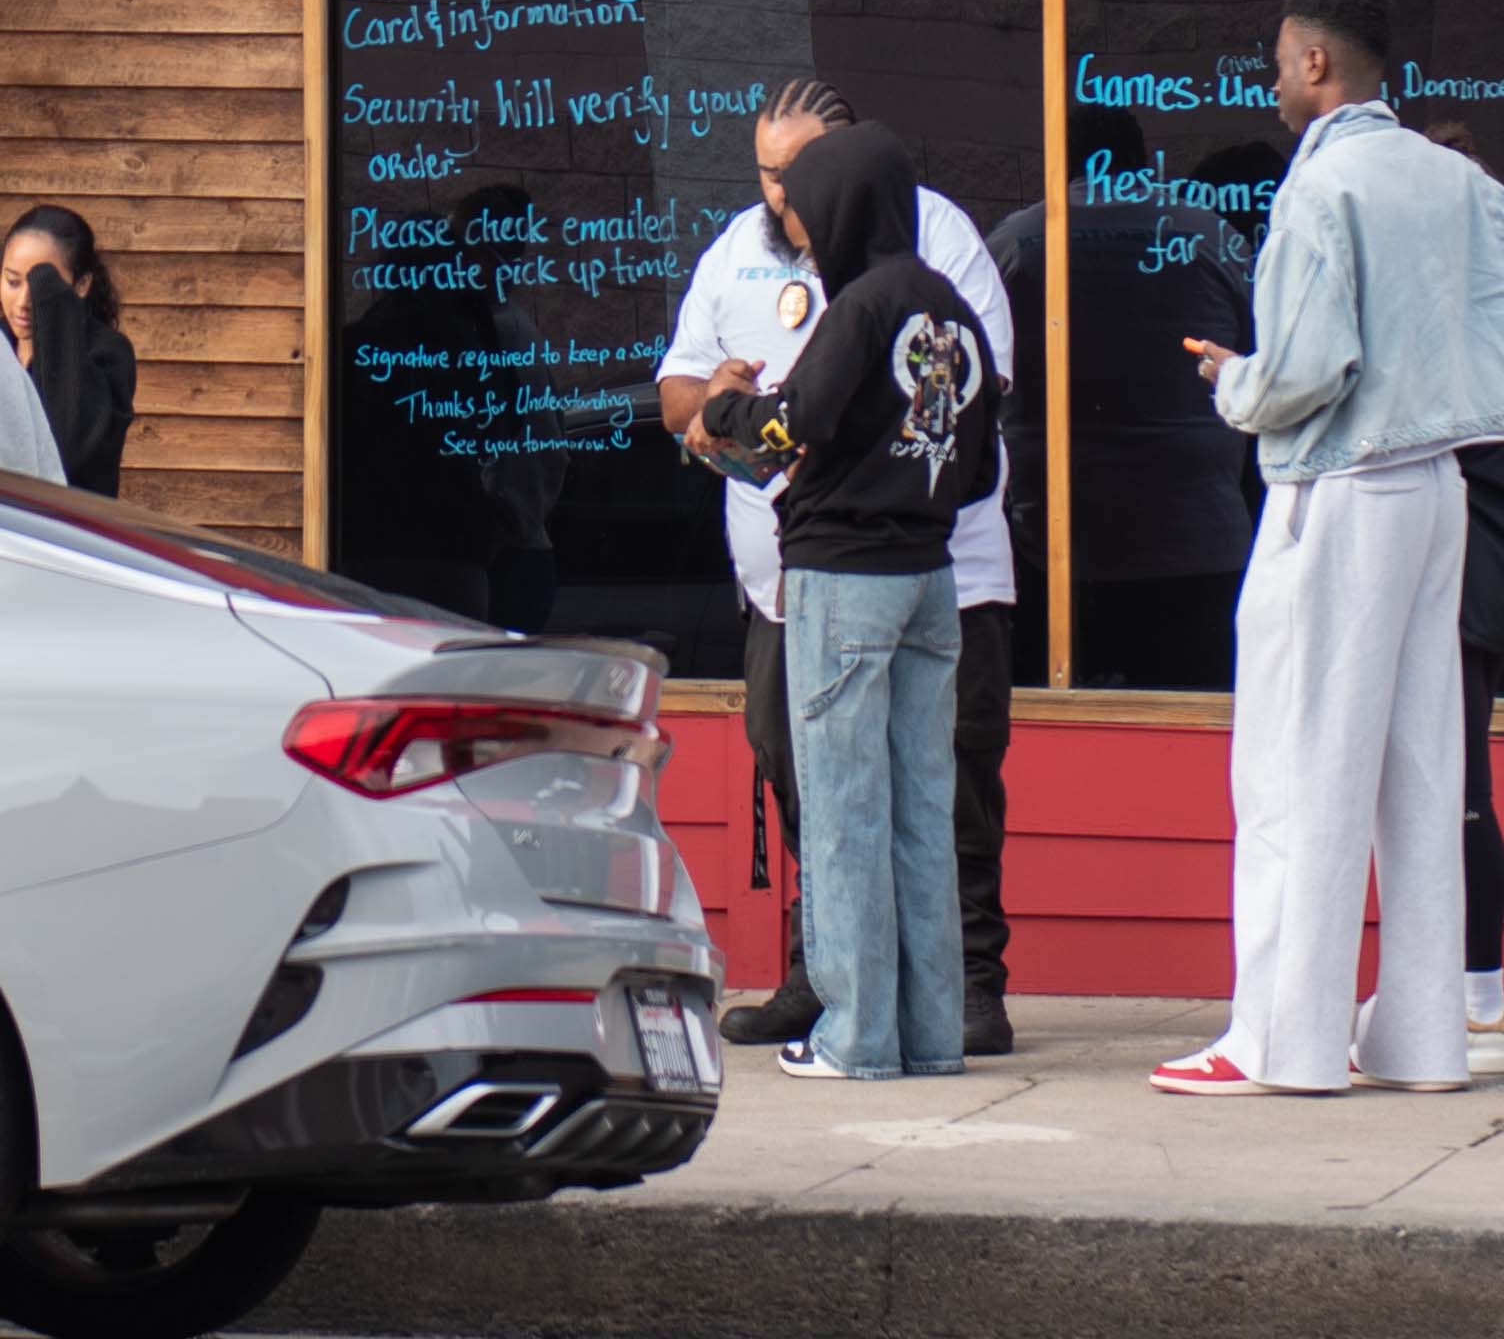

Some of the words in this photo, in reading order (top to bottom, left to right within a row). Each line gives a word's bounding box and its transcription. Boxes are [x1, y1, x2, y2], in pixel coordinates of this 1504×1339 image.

[344, 5, 423, 49] Card
[343, 79, 480, 157] Security
[568, 75, 669, 150] verify
[347, 206, 456, 255] Please
[464, 202, 550, 247] check
[562, 196, 680, 247] emailed
[1137, 214, 1205, 274] far
[352, 250, 488, 291] accurate
[495, 254, 560, 304] pick
[568, 257, 607, 299] up
[354, 343, 450, 382] Signature
[457, 340, 536, 382] required
[539, 338, 561, 365] to
[568, 338, 611, 368] keep
[615, 346, 626, 362] a
[394, 389, 475, 425] Thanks
[477, 389, 508, 430] for
[440, 430, 478, 456] See
[484, 438, 520, 460] you
